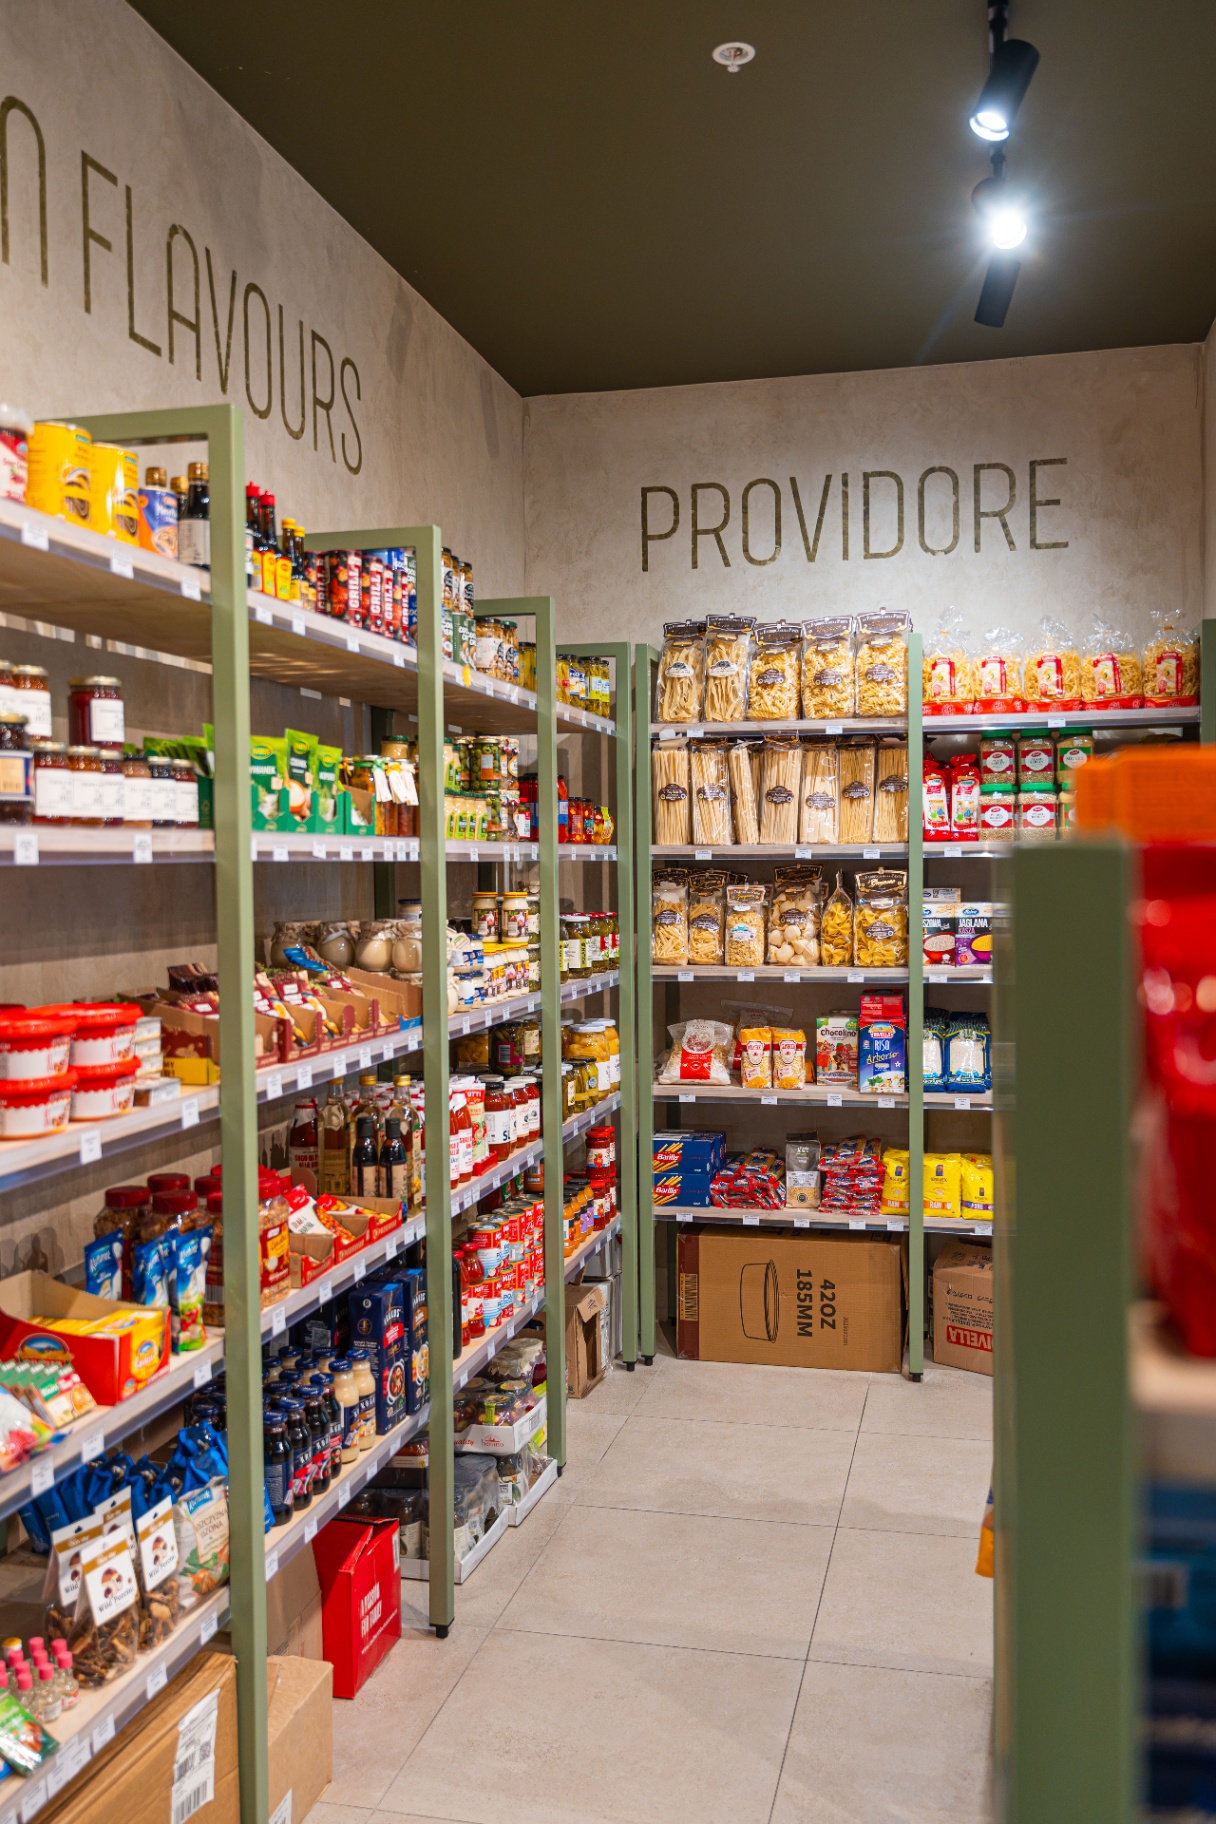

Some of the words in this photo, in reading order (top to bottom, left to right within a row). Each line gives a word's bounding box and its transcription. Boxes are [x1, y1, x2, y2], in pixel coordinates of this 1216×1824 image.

[81, 149, 363, 476] FLAVOURS
[641, 457, 1069, 572] PROVIDORE
[348, 567, 360, 609] GRILL
[370, 573, 381, 614] GRILL
[384, 580, 393, 620] GRILL
[958, 918, 989, 928] JAGLANA
[874, 1038, 890, 1052] RISO
[866, 1051, 898, 1065] Arborio
[656, 1153, 680, 1161] Barilla
[887, 1200, 900, 1208] RAW
[929, 1201, 942, 1209] RAW
[796, 1269, 813, 1337] 185MM
[820, 1279, 837, 1330] 42OZ
[64, 1582, 79, 1595] Wild
[98, 1600, 113, 1614] Wild
